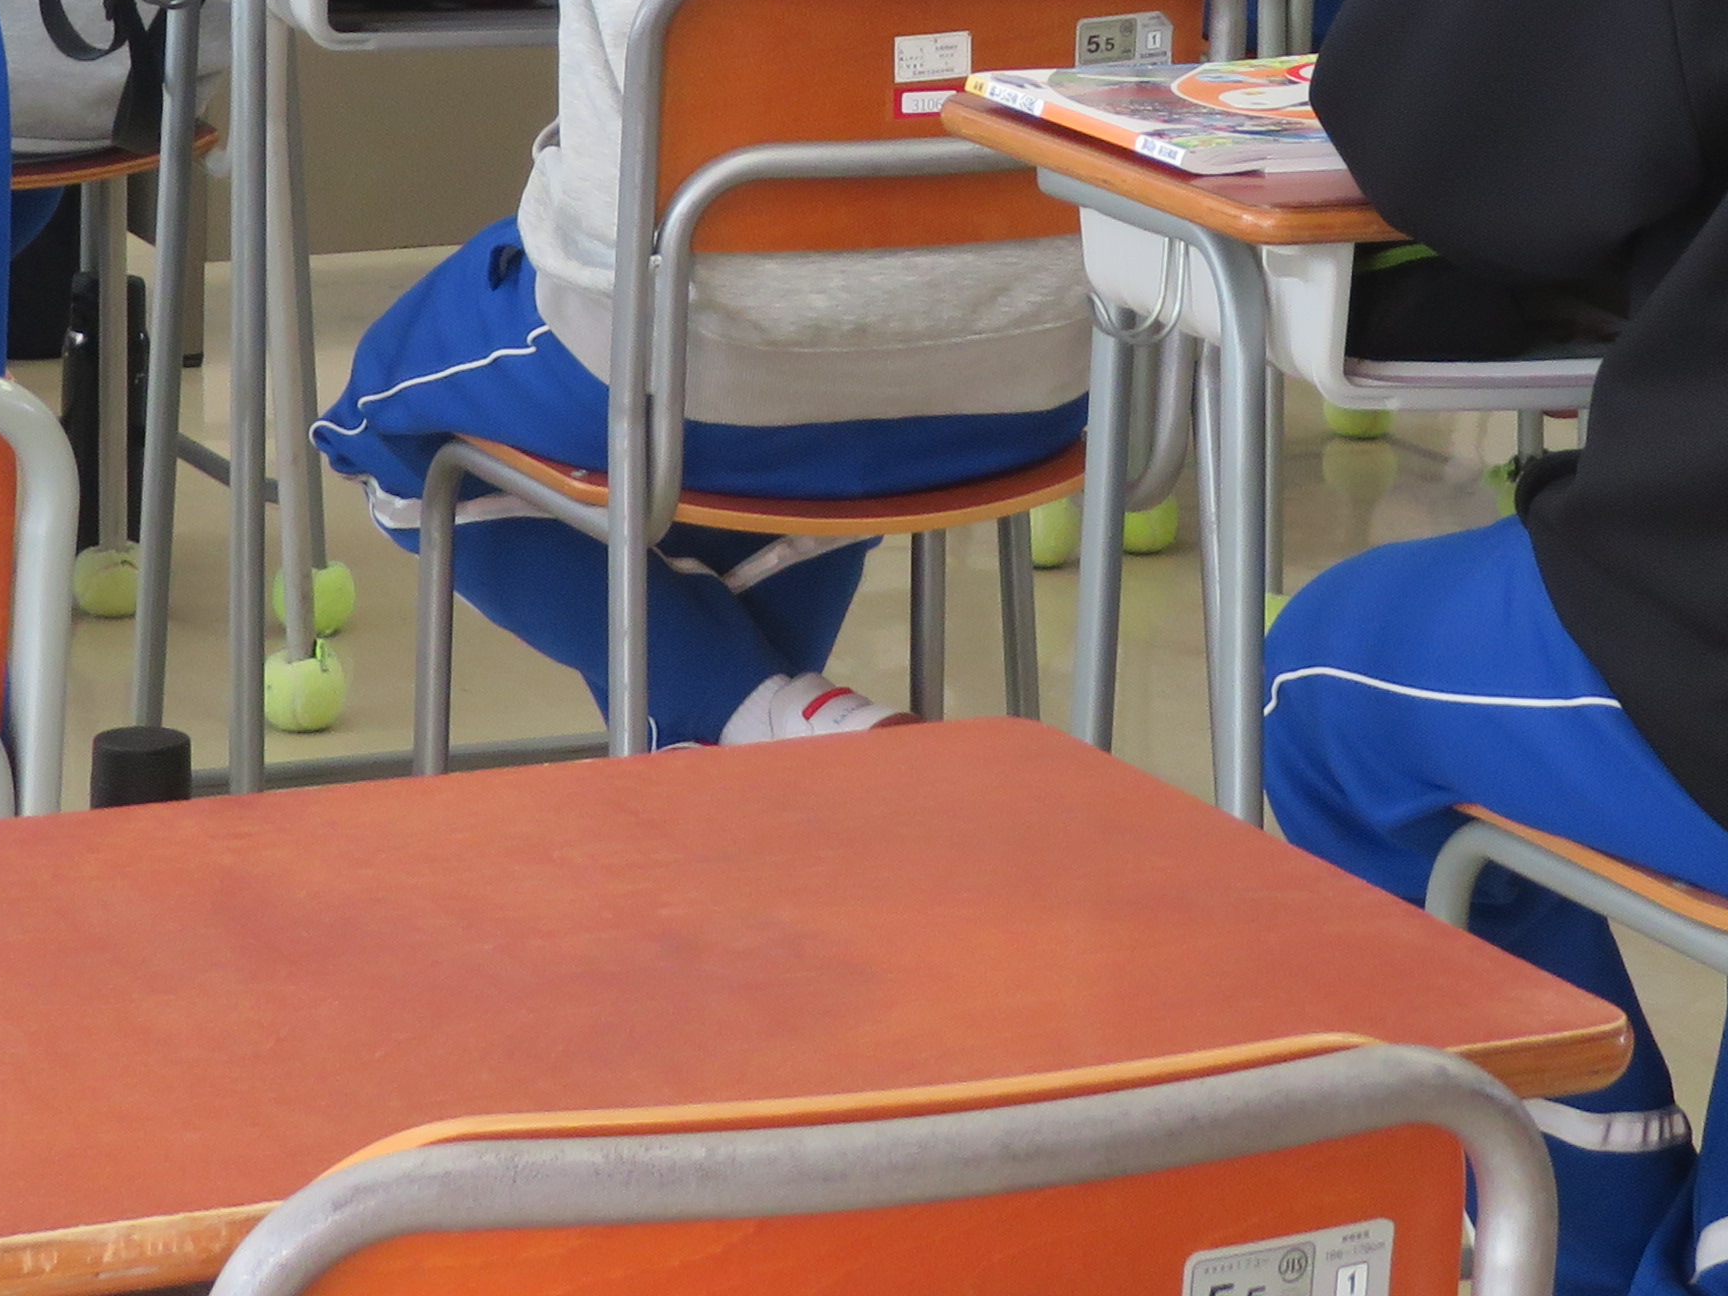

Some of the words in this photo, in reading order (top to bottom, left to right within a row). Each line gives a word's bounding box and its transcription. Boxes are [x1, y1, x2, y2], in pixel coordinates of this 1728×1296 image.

[1087, 34, 1116, 54] 5.5
[1151, 35, 1158, 47] 1
[912, 97, 943, 113] 3106
[1283, 1254, 1306, 1276] JIS
